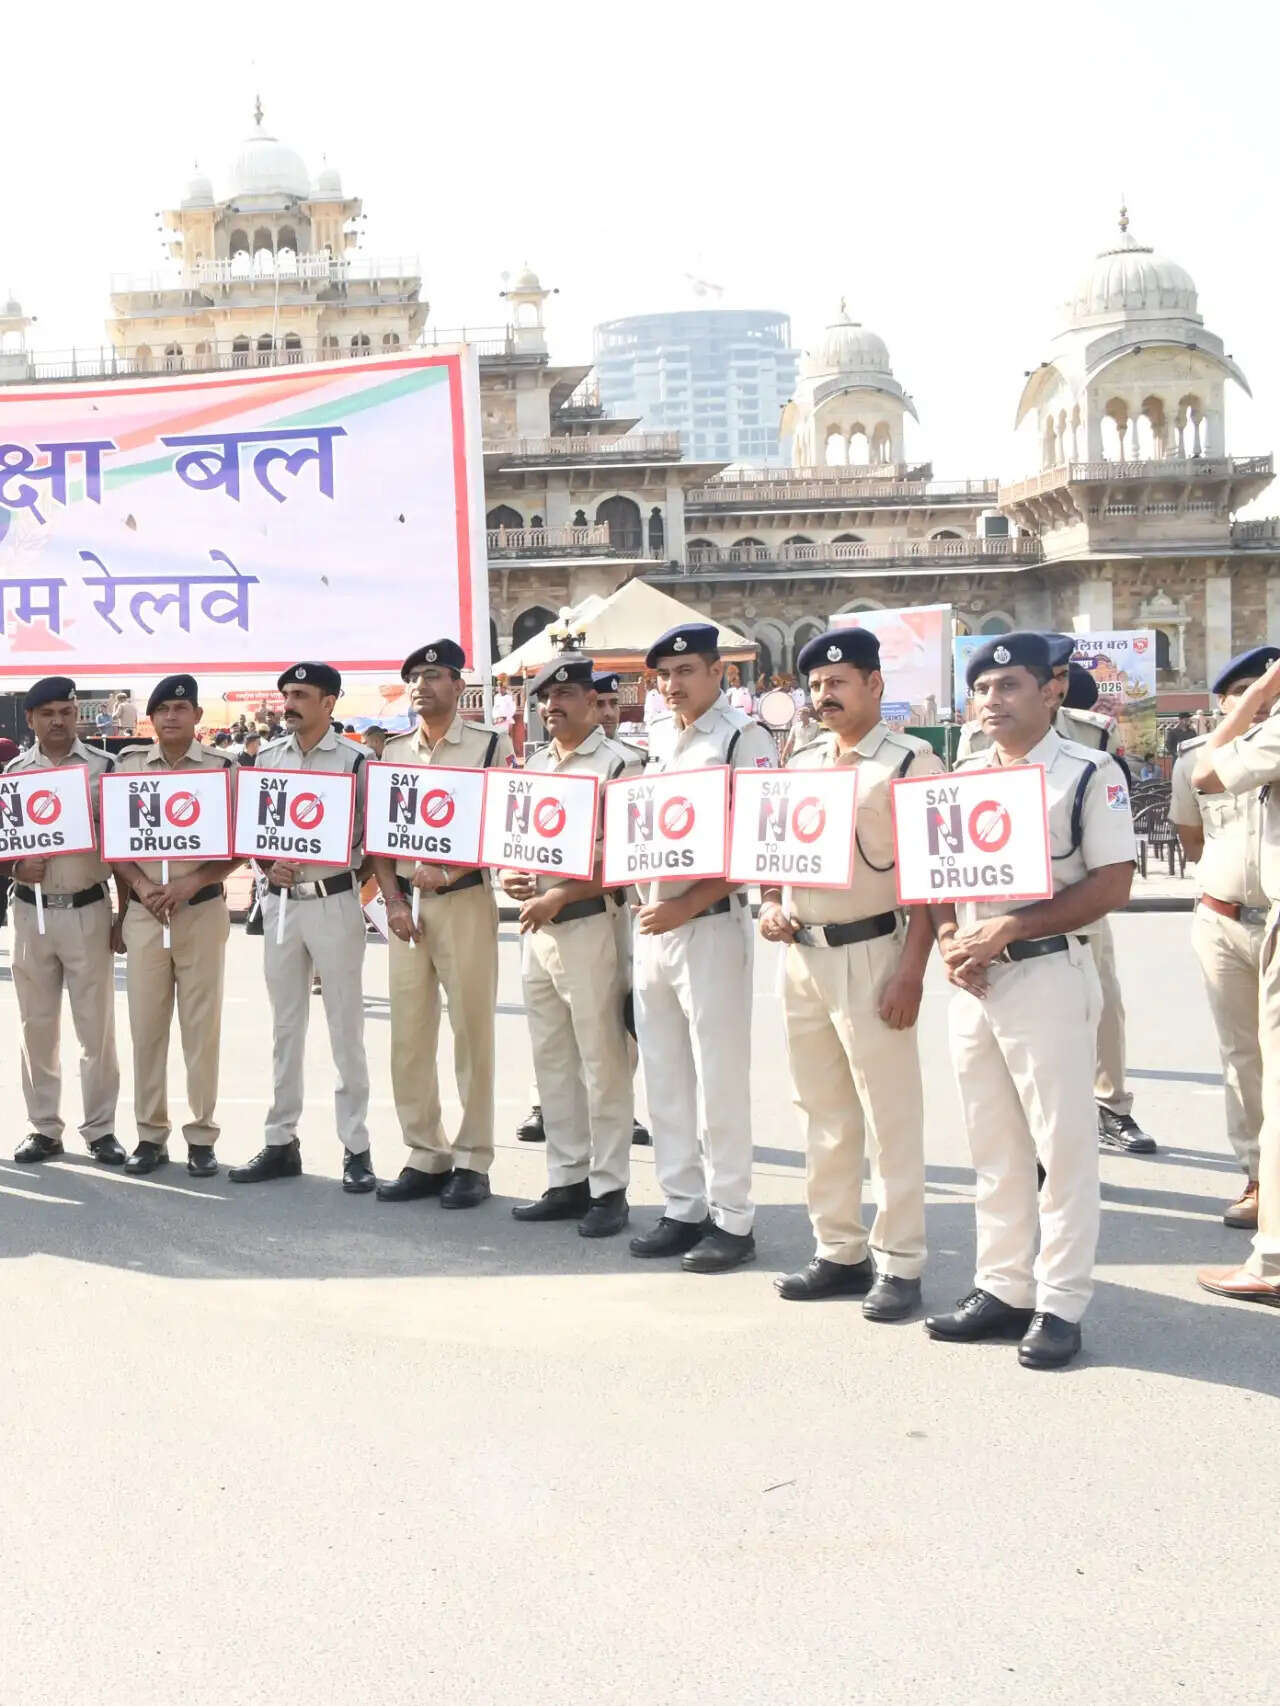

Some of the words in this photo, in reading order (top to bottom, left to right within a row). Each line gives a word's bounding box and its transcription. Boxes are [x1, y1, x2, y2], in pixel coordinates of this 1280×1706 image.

[161, 427, 347, 500] बल
[82, 551, 259, 636] रेलवे
[129, 781, 159, 793] SAY
[261, 778, 288, 791] SAY
[392, 773, 419, 787] SAY
[508, 780, 533, 794] SAY
[628, 787, 655, 802] SAY
[762, 781, 791, 796] SAY
[926, 787, 959, 805] SAY
[3, 828, 17, 836] TO
[139, 828, 153, 836] TO
[265, 827, 277, 835] TO
[396, 824, 408, 833] TO
[130, 835, 200, 851] DRUGS
[257, 835, 321, 854] DRUGS
[388, 832, 451, 853] DRUGS
[512, 834, 528, 843] TO
[504, 843, 562, 865] DRUGS
[628, 849, 694, 872] DRUGS
[939, 856, 955, 866] TO
[756, 854, 821, 874] DRUGS
[931, 864, 1014, 888] DRUGS
